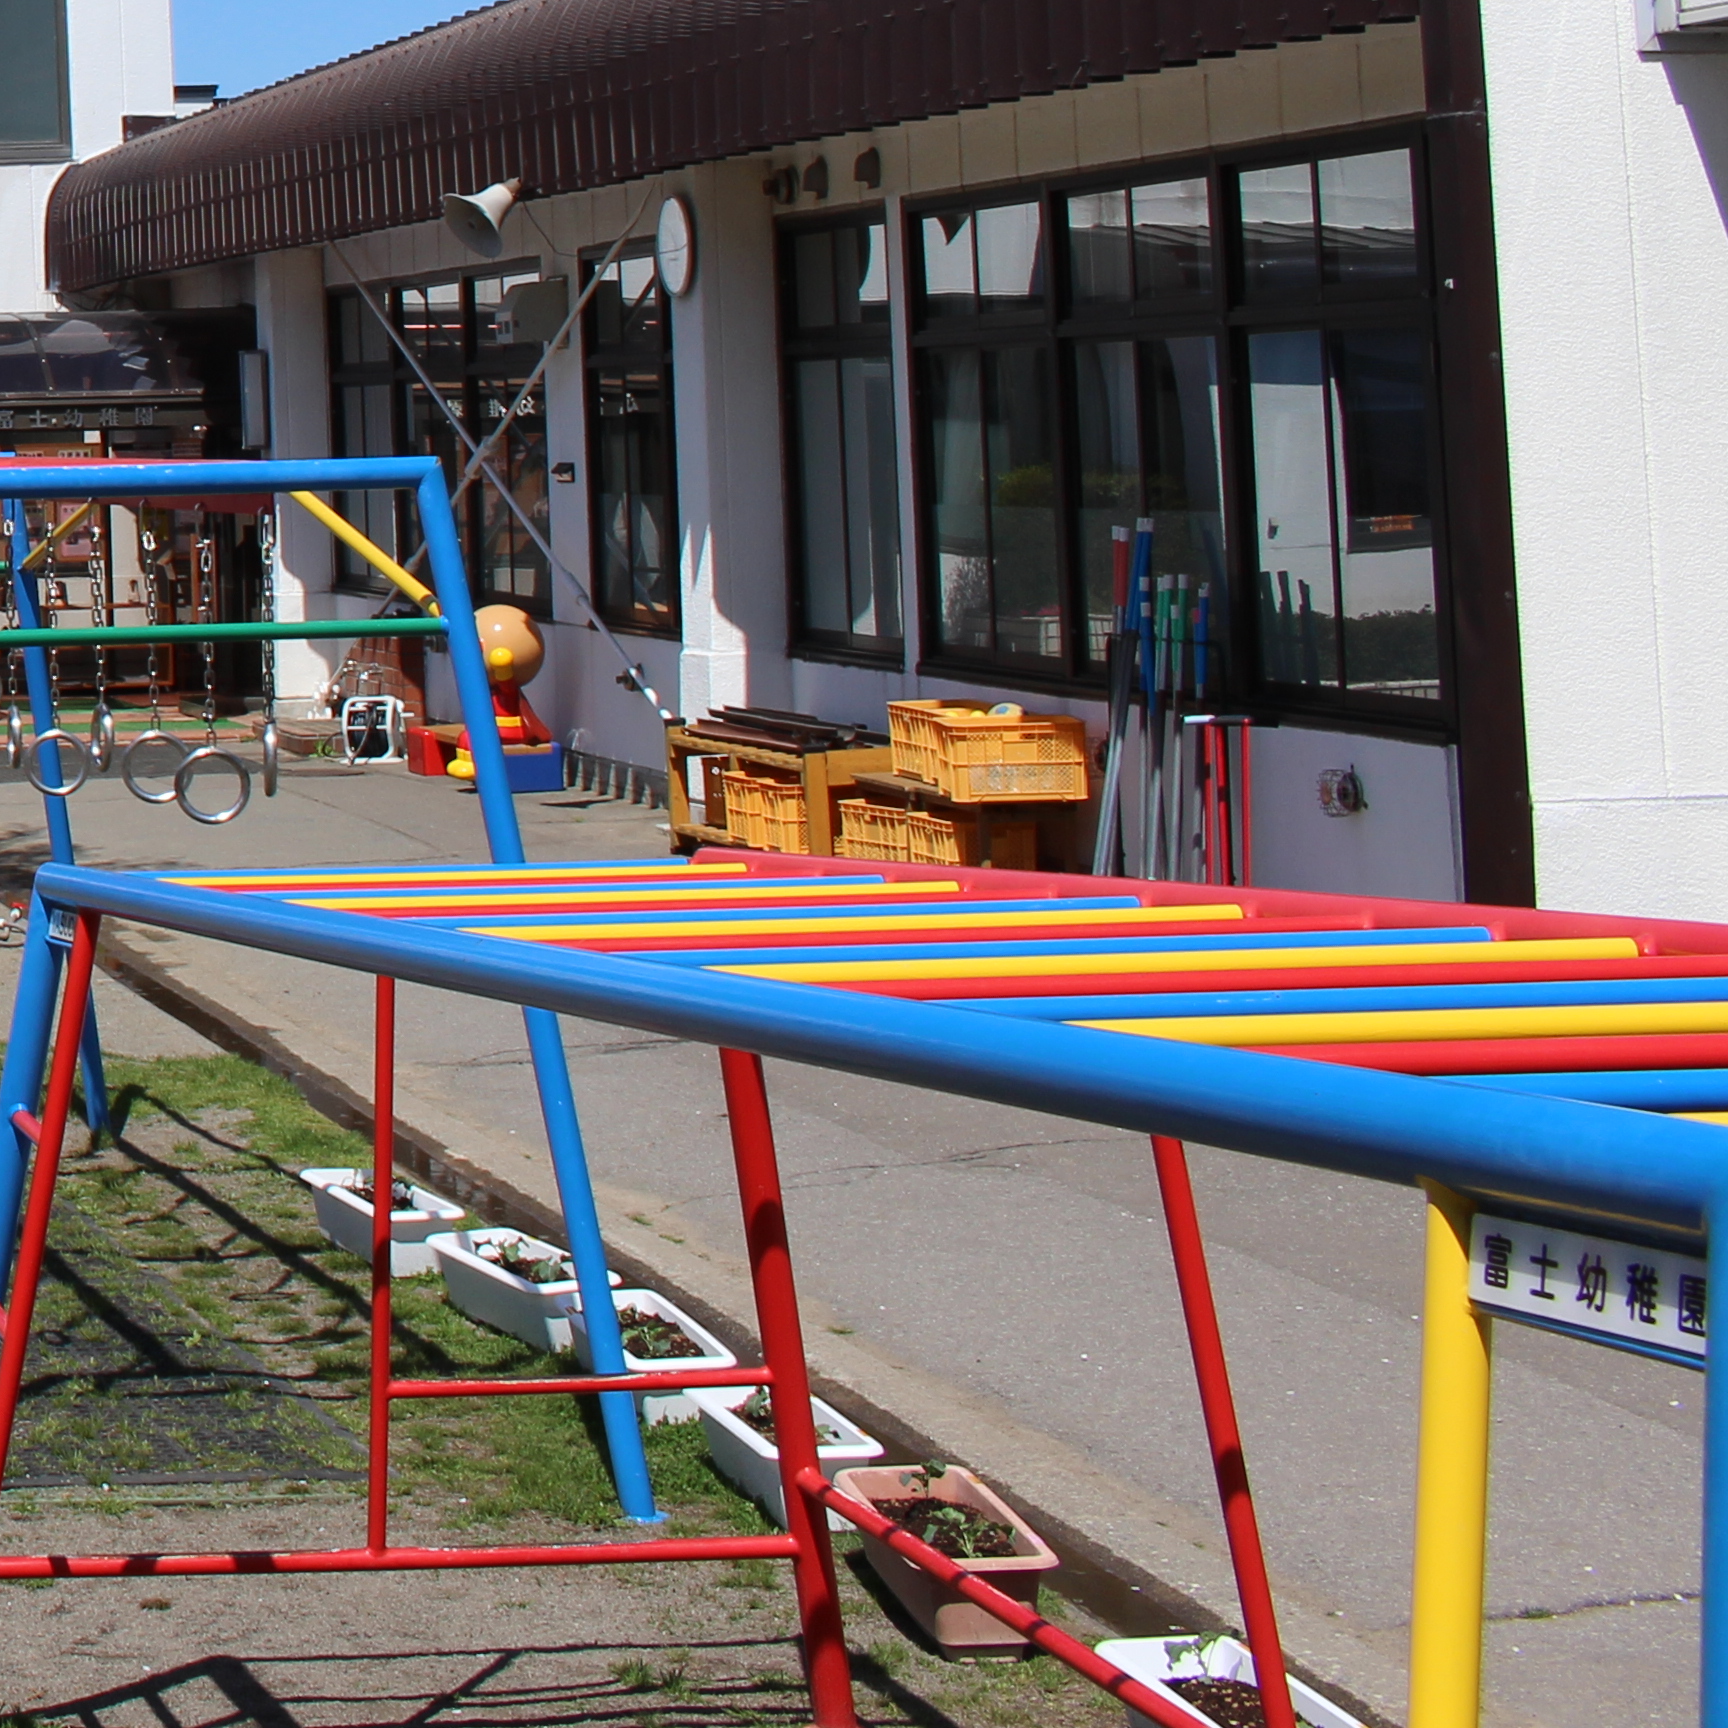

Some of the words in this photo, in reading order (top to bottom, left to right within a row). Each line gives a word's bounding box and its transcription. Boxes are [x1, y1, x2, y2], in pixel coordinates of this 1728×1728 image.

[1483, 1232, 1707, 1337] 富士幼稚園
